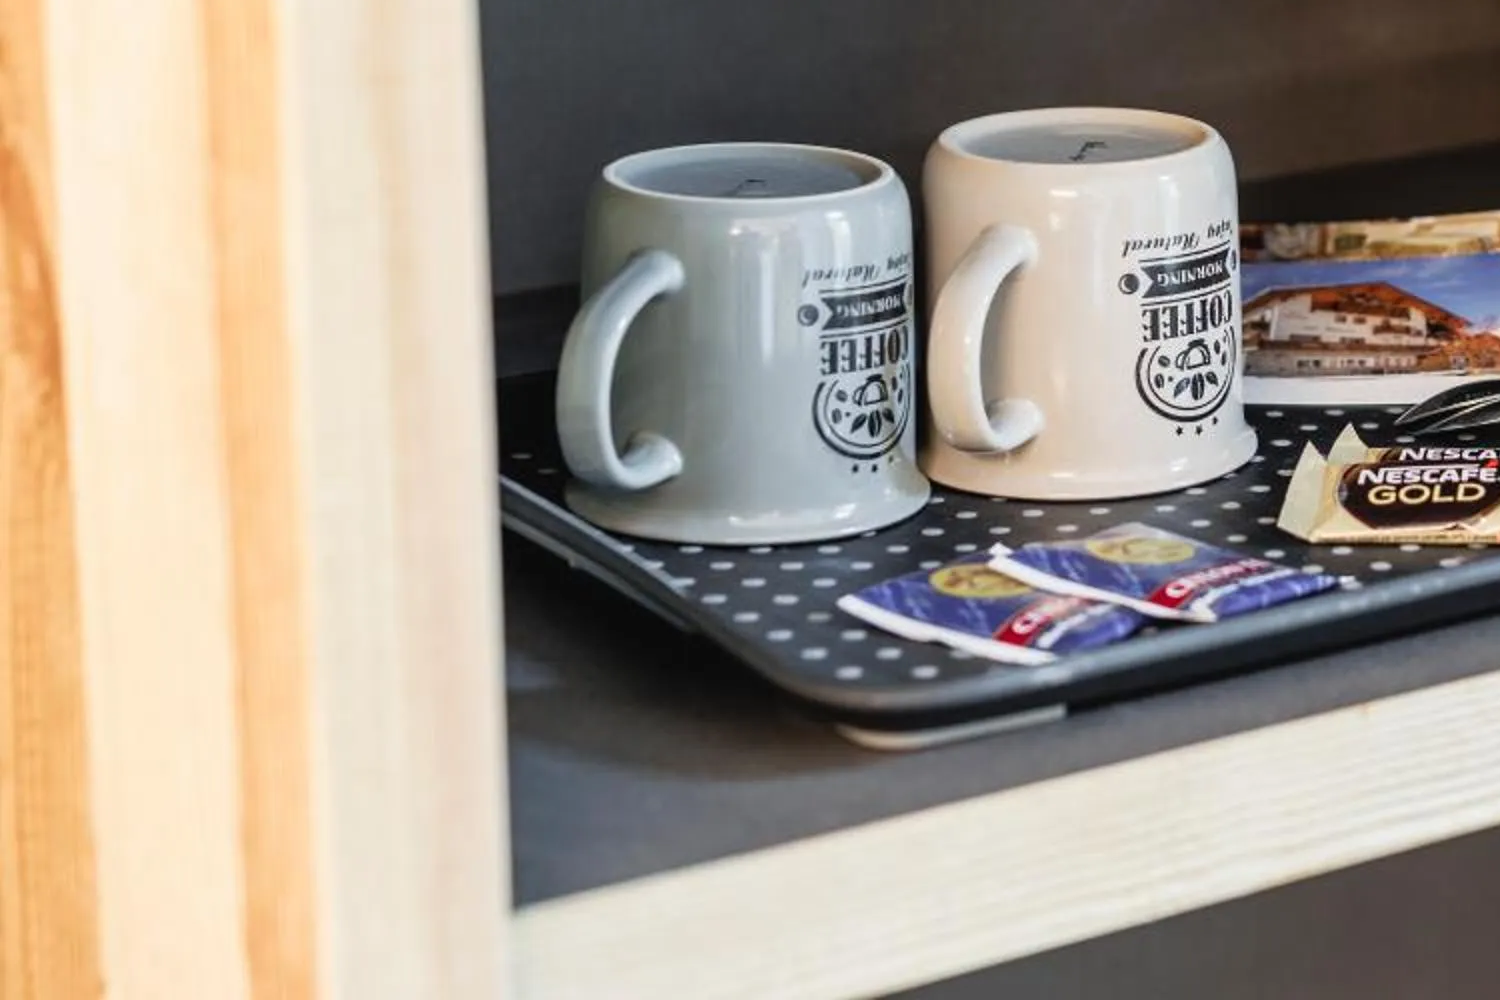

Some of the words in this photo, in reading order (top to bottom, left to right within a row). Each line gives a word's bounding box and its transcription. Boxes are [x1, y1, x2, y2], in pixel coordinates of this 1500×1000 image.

[1121, 232, 1201, 259] Natural
[1157, 260, 1223, 287] MORNING
[1141, 289, 1233, 342] COFFEE
[819, 325, 909, 376] COFFEE
[1367, 483, 1486, 505] GOLD
